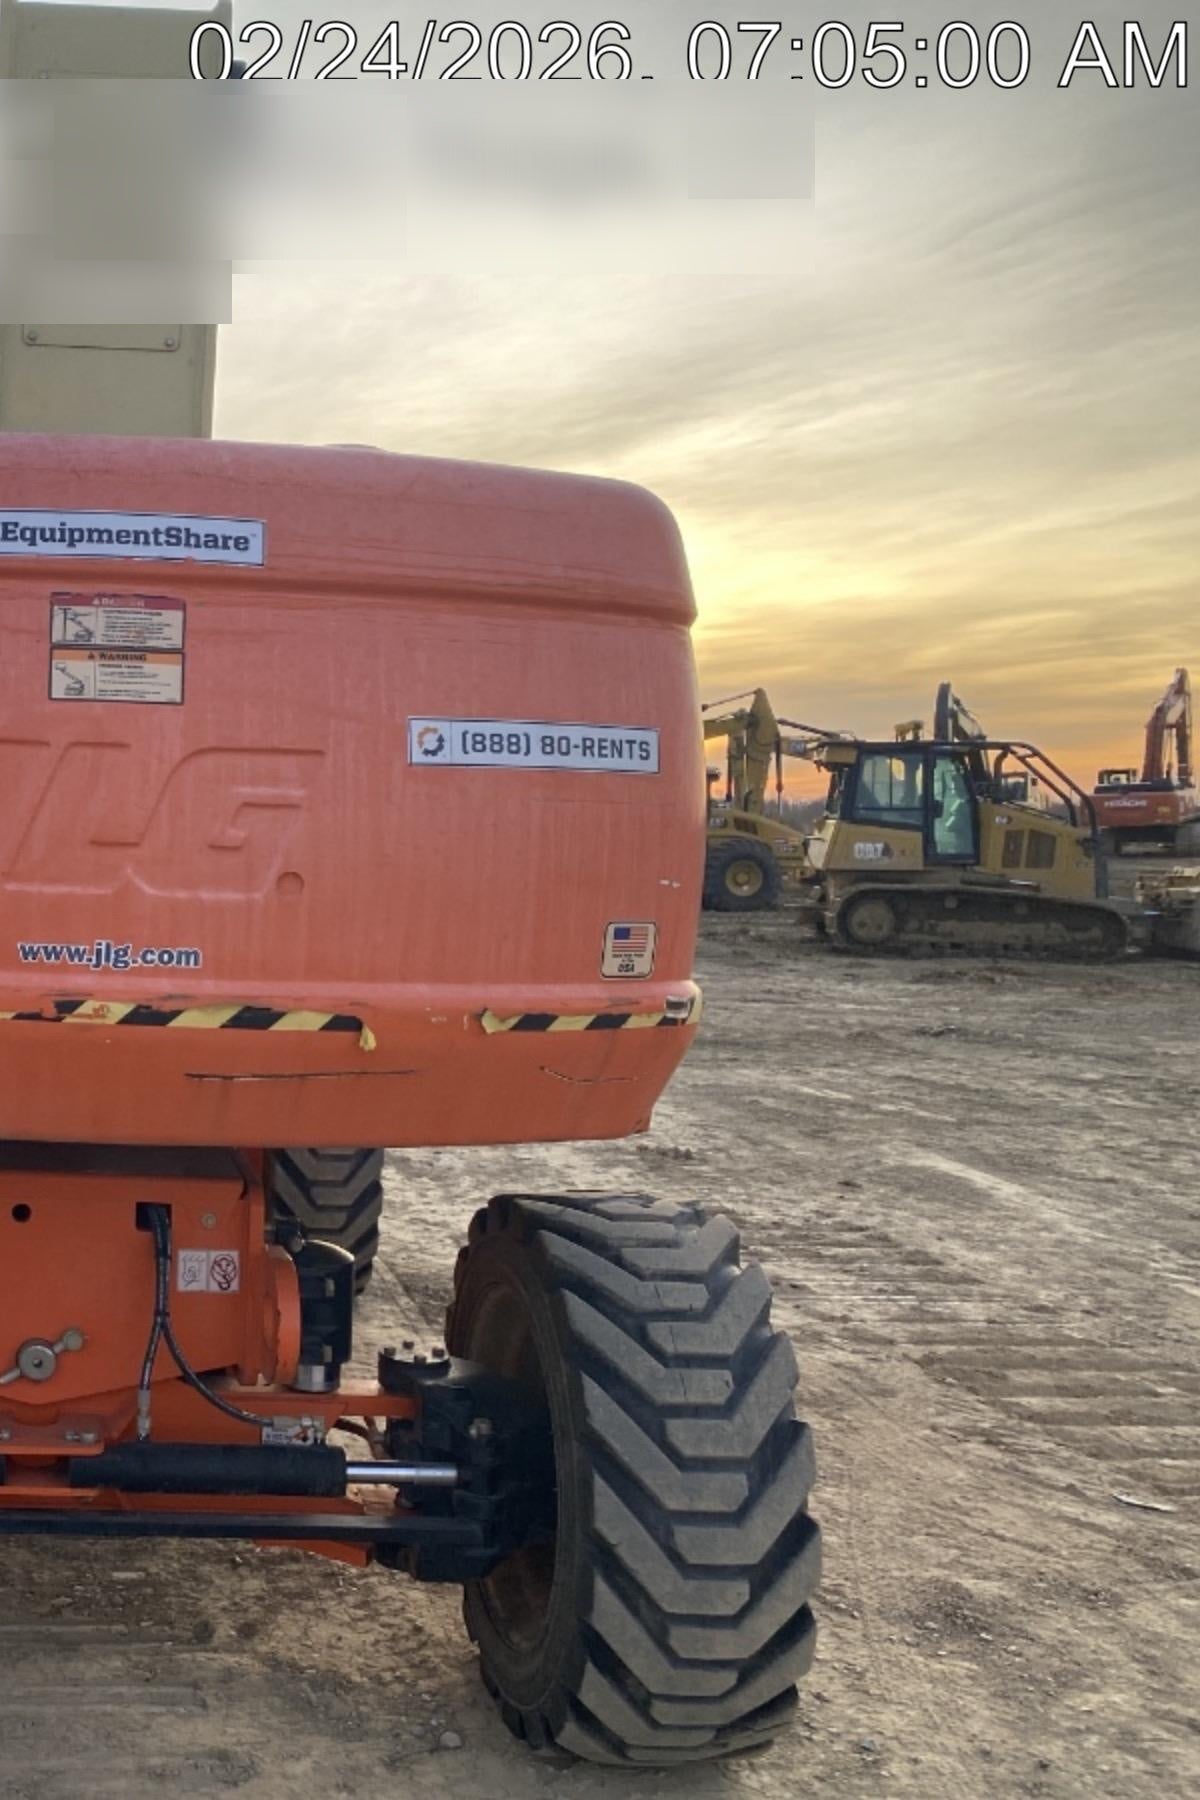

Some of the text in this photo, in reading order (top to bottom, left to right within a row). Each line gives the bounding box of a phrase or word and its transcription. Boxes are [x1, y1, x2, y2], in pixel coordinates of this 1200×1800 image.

[0, 521, 250, 551] EquipmentShare
[99, 652, 147, 662] WARNING
[461, 730, 650, 761] (888) 80-RENTS
[18, 941, 202, 970] www.jlg.com
